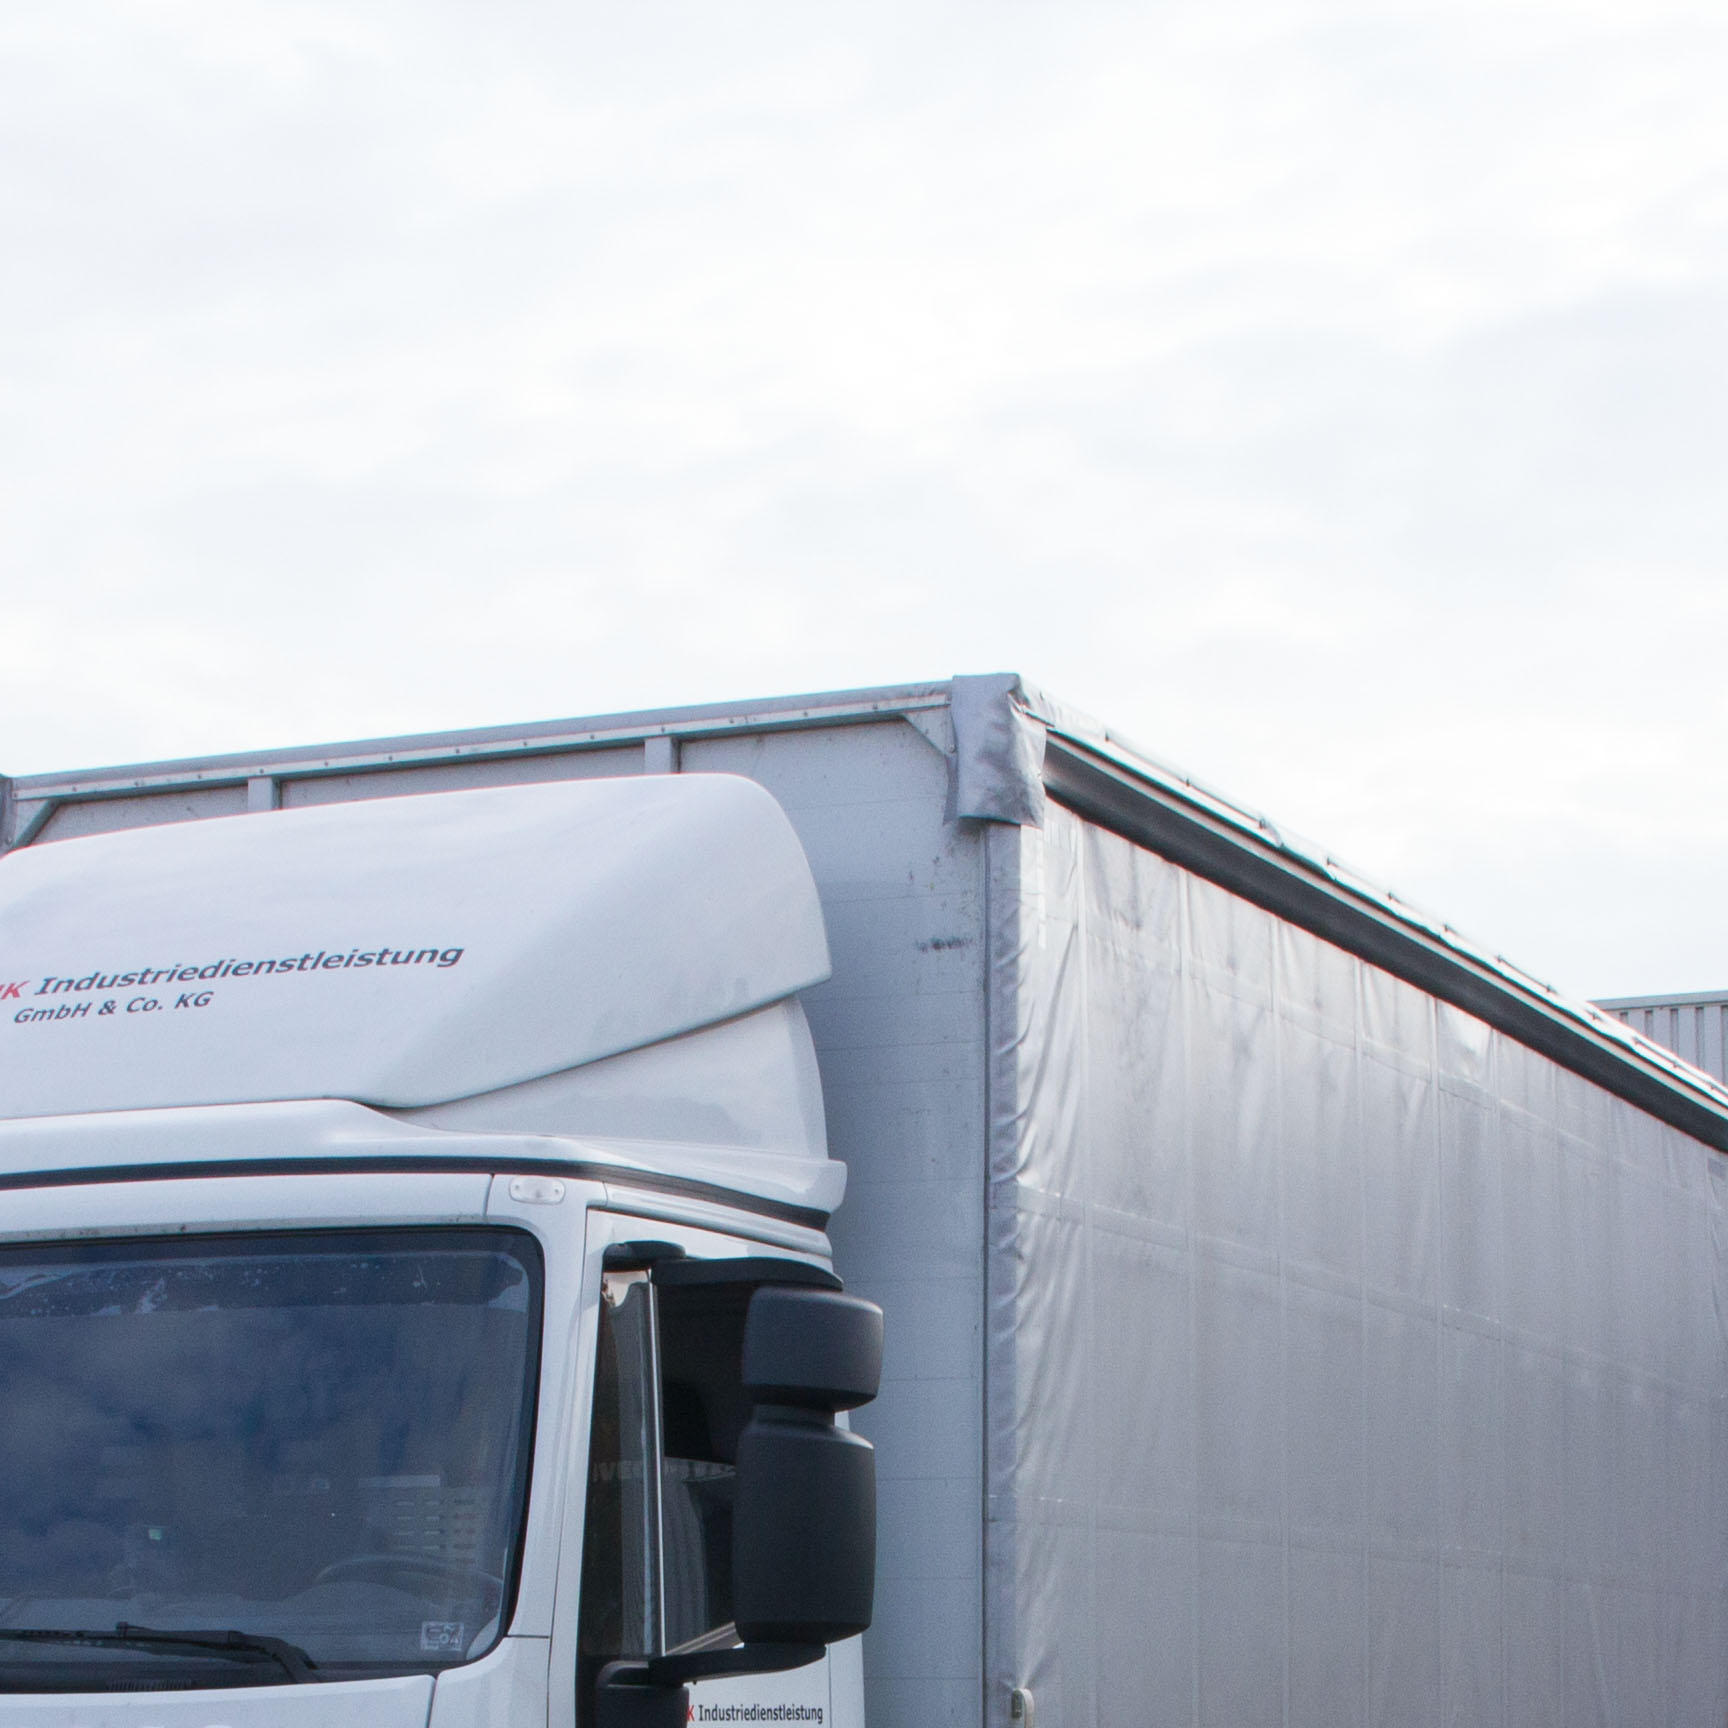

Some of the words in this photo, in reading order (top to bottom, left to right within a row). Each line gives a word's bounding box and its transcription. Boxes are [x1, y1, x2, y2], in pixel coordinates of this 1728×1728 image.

[34, 945, 465, 997] Industriedienstleistung
[13, 1001, 92, 1024] GmbH
[98, 1001, 119, 1016] &
[126, 996, 164, 1014] Co.
[175, 991, 214, 1009] KG
[698, 1704, 823, 1724] Industriedienstleistung
